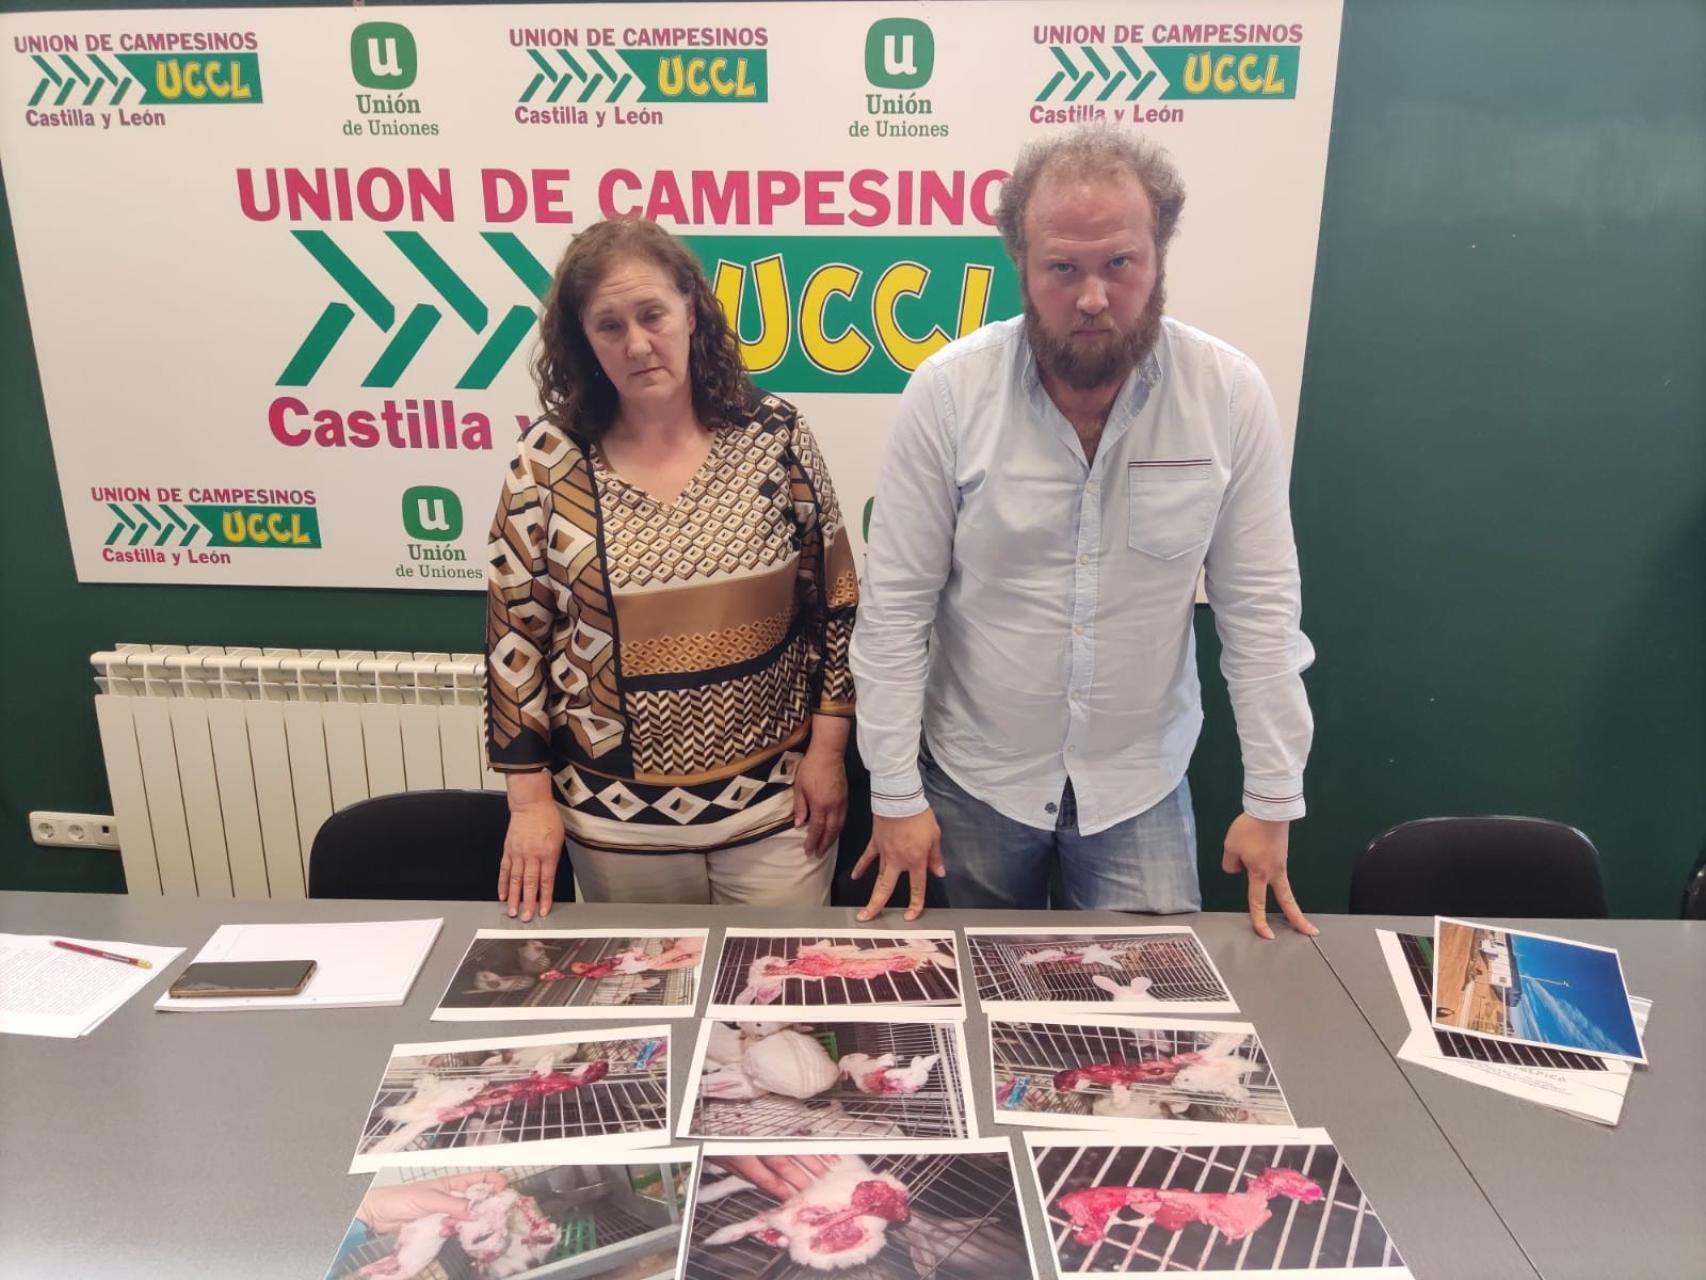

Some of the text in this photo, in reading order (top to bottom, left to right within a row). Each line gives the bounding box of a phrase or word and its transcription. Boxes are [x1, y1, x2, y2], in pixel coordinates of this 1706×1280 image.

[14, 32, 257, 53] UNION DE CAMPESINOS
[510, 27, 768, 46] UNION DE CAMPESINOS
[1034, 24, 1303, 44] UNION DE CAMPESINOS
[156, 60, 250, 98] UCCL
[659, 56, 755, 97] UCCL
[1184, 53, 1284, 93] UCCL
[356, 92, 421, 114] Unión
[866, 92, 932, 114] Unión
[26, 109, 165, 129] Castilla y León
[515, 106, 663, 128] Castilla y León
[1030, 105, 1105, 124] Castilla
[1133, 104, 1183, 123] León
[343, 120, 439, 135] de Uniones
[849, 121, 948, 137] de Uniones
[237, 167, 1010, 227] UNION DE CAMPESINO
[268, 397, 492, 450] Castilla
[91, 488, 316, 504] UNION DE CAMPESINOS
[223, 510, 309, 544] UCCL
[102, 548, 230, 566] Castilla y León
[408, 544, 466, 561] Unión
[396, 564, 482, 579] de Uniones
